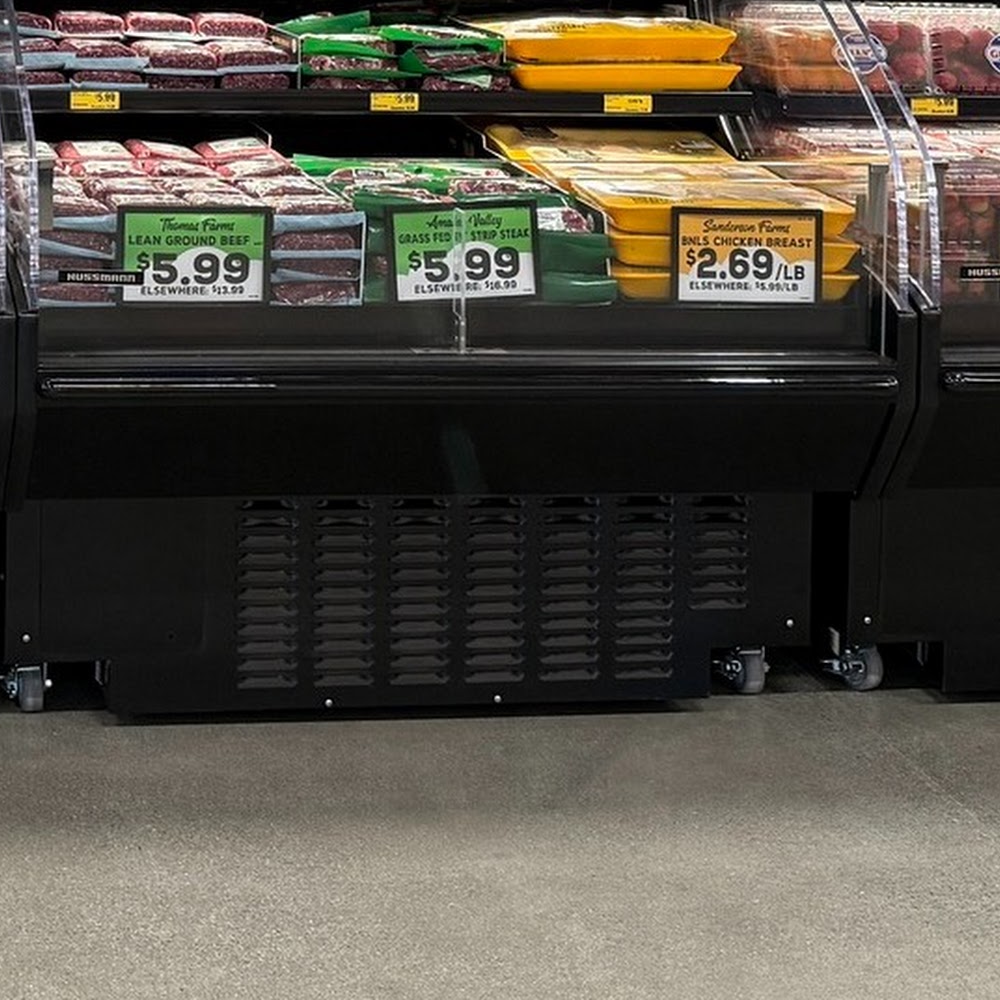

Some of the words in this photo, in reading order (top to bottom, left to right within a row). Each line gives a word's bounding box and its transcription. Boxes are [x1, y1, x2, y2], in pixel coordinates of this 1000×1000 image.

[160, 217, 199, 232] Thomas
[202, 217, 236, 232] Farms
[468, 213, 503, 230] Valley
[703, 218, 757, 234] Sanderson
[758, 220, 792, 234] Farms
[128, 235, 162, 246] LEAN
[165, 235, 216, 246] GROUND
[220, 235, 250, 246] BEEF
[398, 233, 431, 244] GRASS
[433, 231, 451, 242] FED
[471, 230, 498, 241] STRIP
[500, 228, 529, 239] STEAK
[681, 236, 710, 246] BNLS
[713, 236, 762, 247] CHICKEN
[766, 238, 813, 248] BREAST
[136, 251, 250, 285] $5.99
[408, 246, 520, 283] $5.99
[686, 247, 806, 281] $2.69/LB
